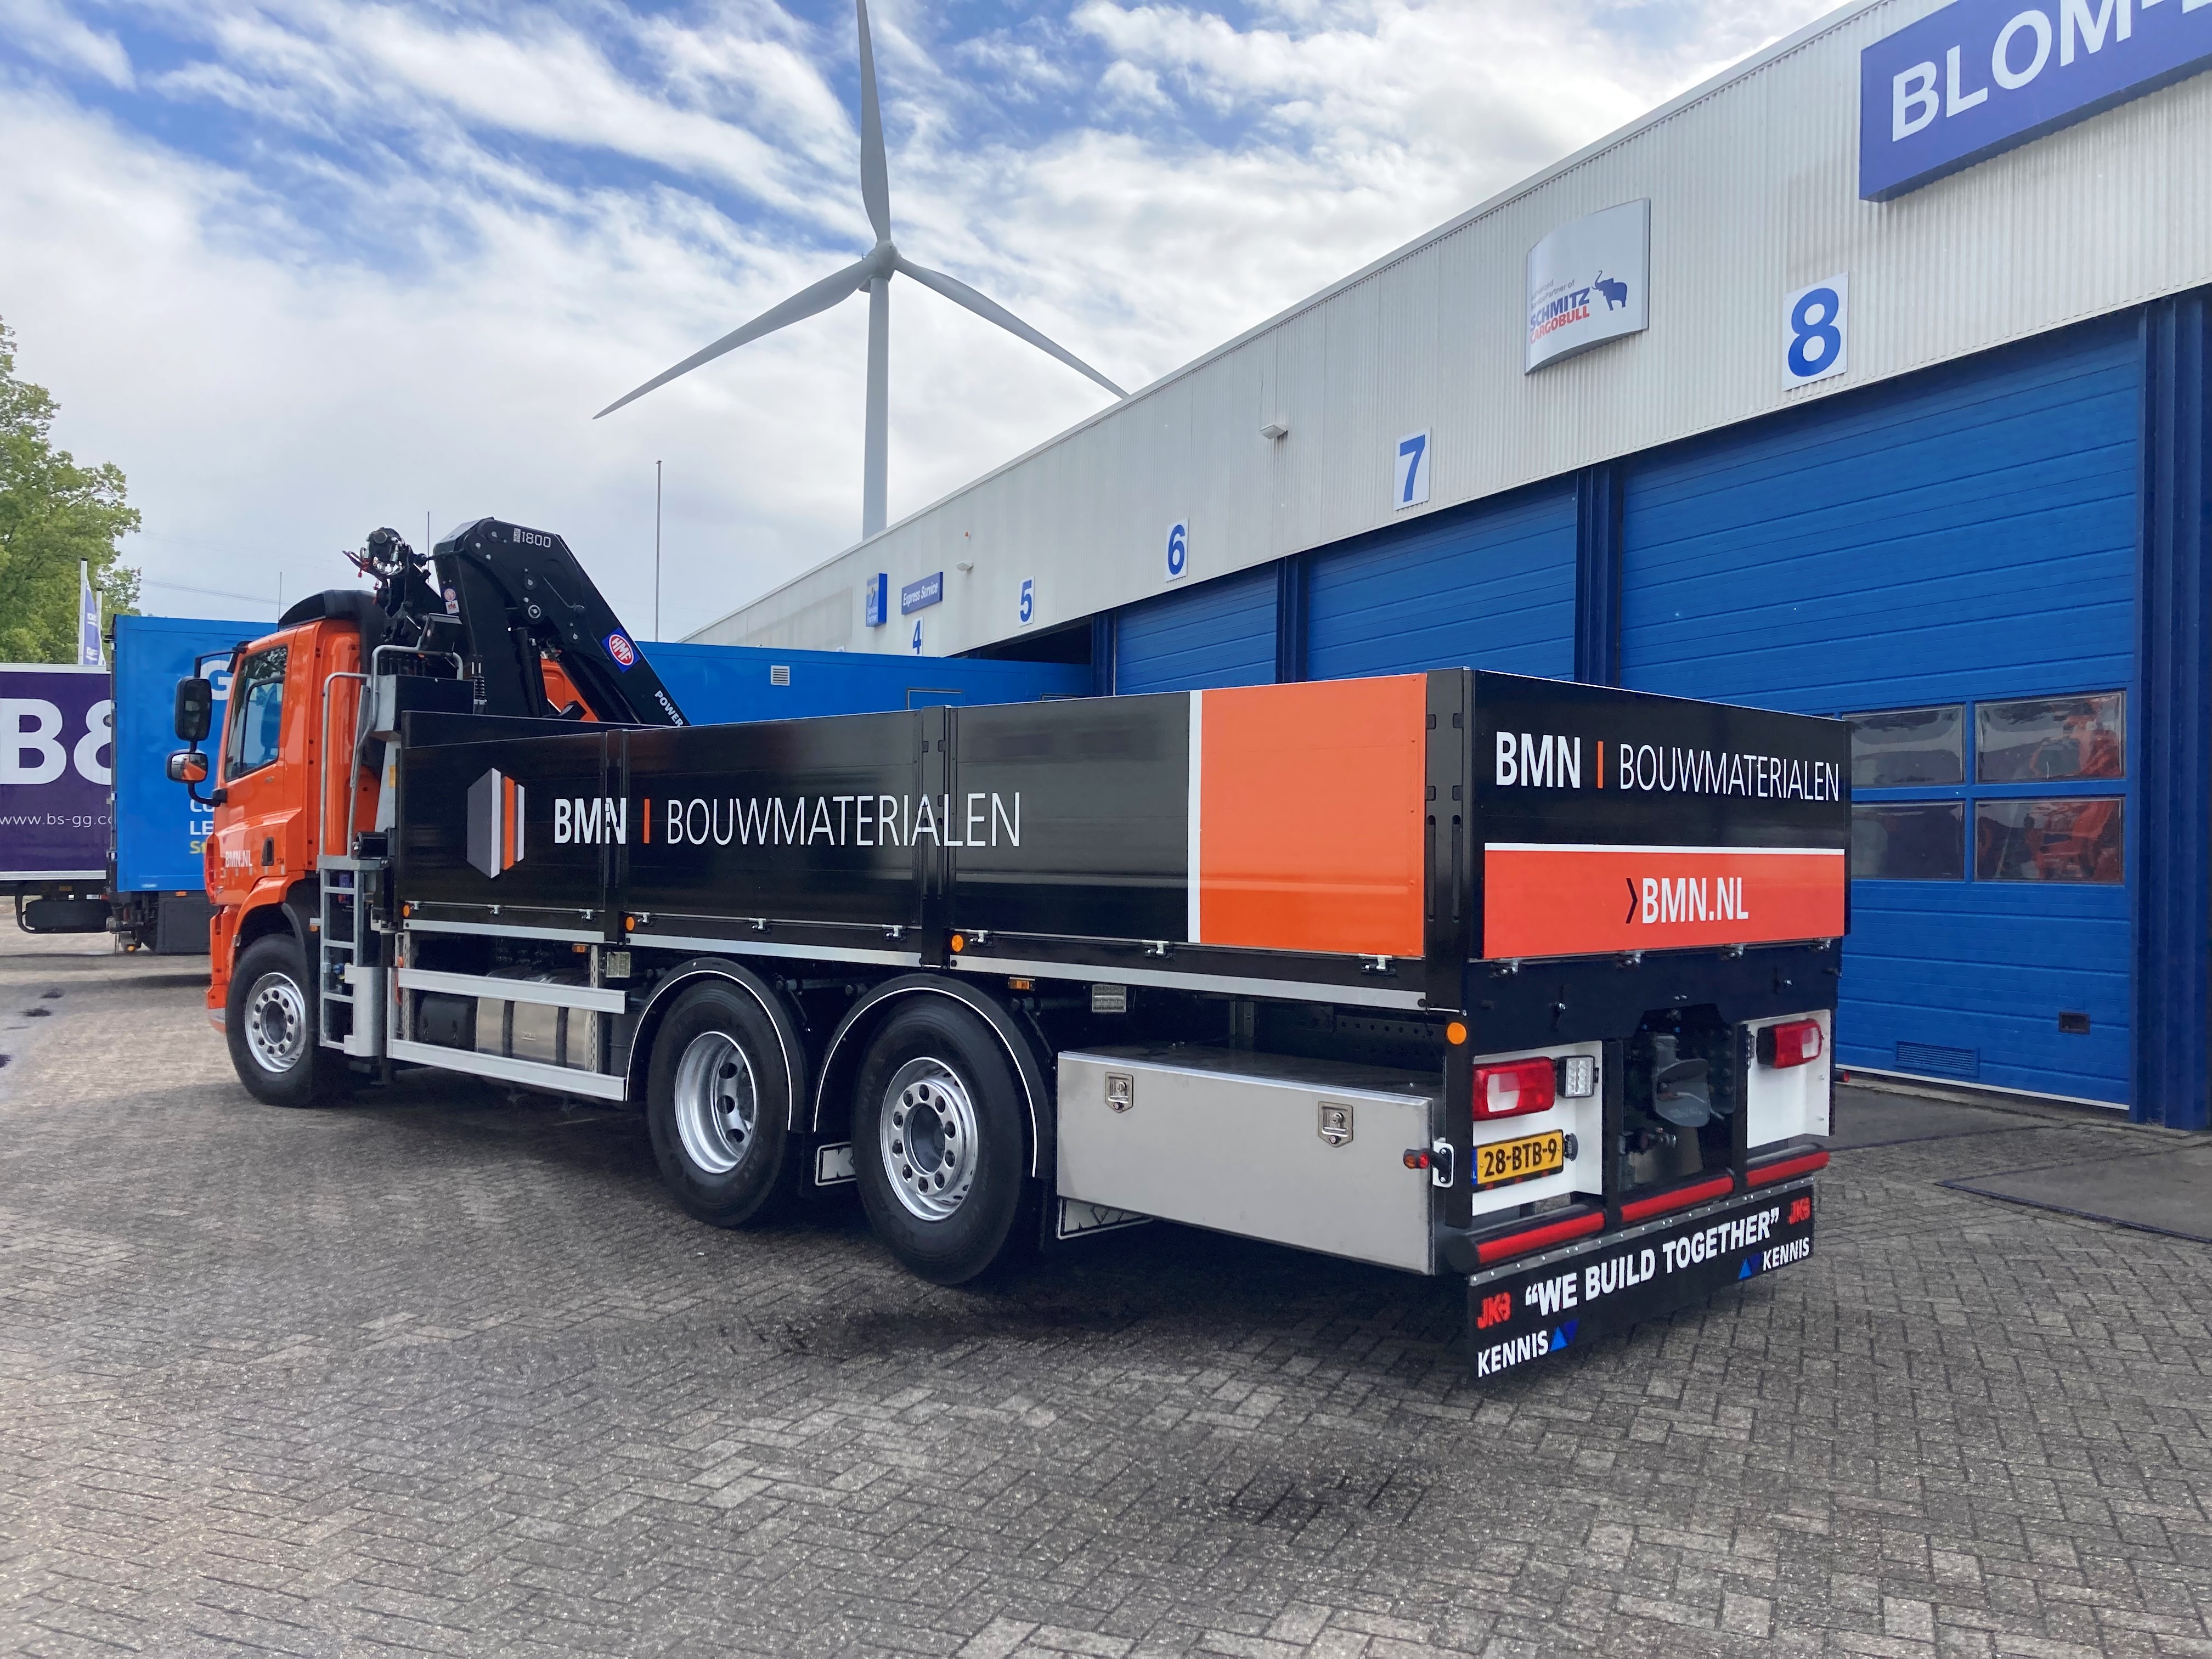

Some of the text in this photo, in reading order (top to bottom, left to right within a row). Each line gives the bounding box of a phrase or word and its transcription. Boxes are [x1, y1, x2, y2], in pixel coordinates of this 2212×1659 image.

[1892, 0, 2212, 142] BLOM-
[1530, 306, 1590, 345] CARGOBULL
[1531, 287, 1590, 331] SCHMITZ
[1788, 287, 1841, 377] 8
[1400, 434, 1426, 503] 7
[522, 531, 551, 548] 1800
[1167, 524, 1186, 575] 6
[903, 582, 938, 607] Express Service
[1020, 579, 1032, 623] 5
[611, 638, 631, 661] HMF
[912, 620, 922, 655] 4
[654, 690, 684, 726] POWER
[1496, 731, 1839, 802] BMN BOUWMATERIALEN
[554, 792, 1020, 847] BMN BOUWMATERIALEN
[1641, 877, 1750, 924] BMN.NL
[1484, 1138, 1557, 1177] 28-BTB-9
[1585, 1248, 1656, 1301] BUILD
[1762, 1237, 1809, 1271] KENNIS
[1477, 1330, 1549, 1378] KENNIS
